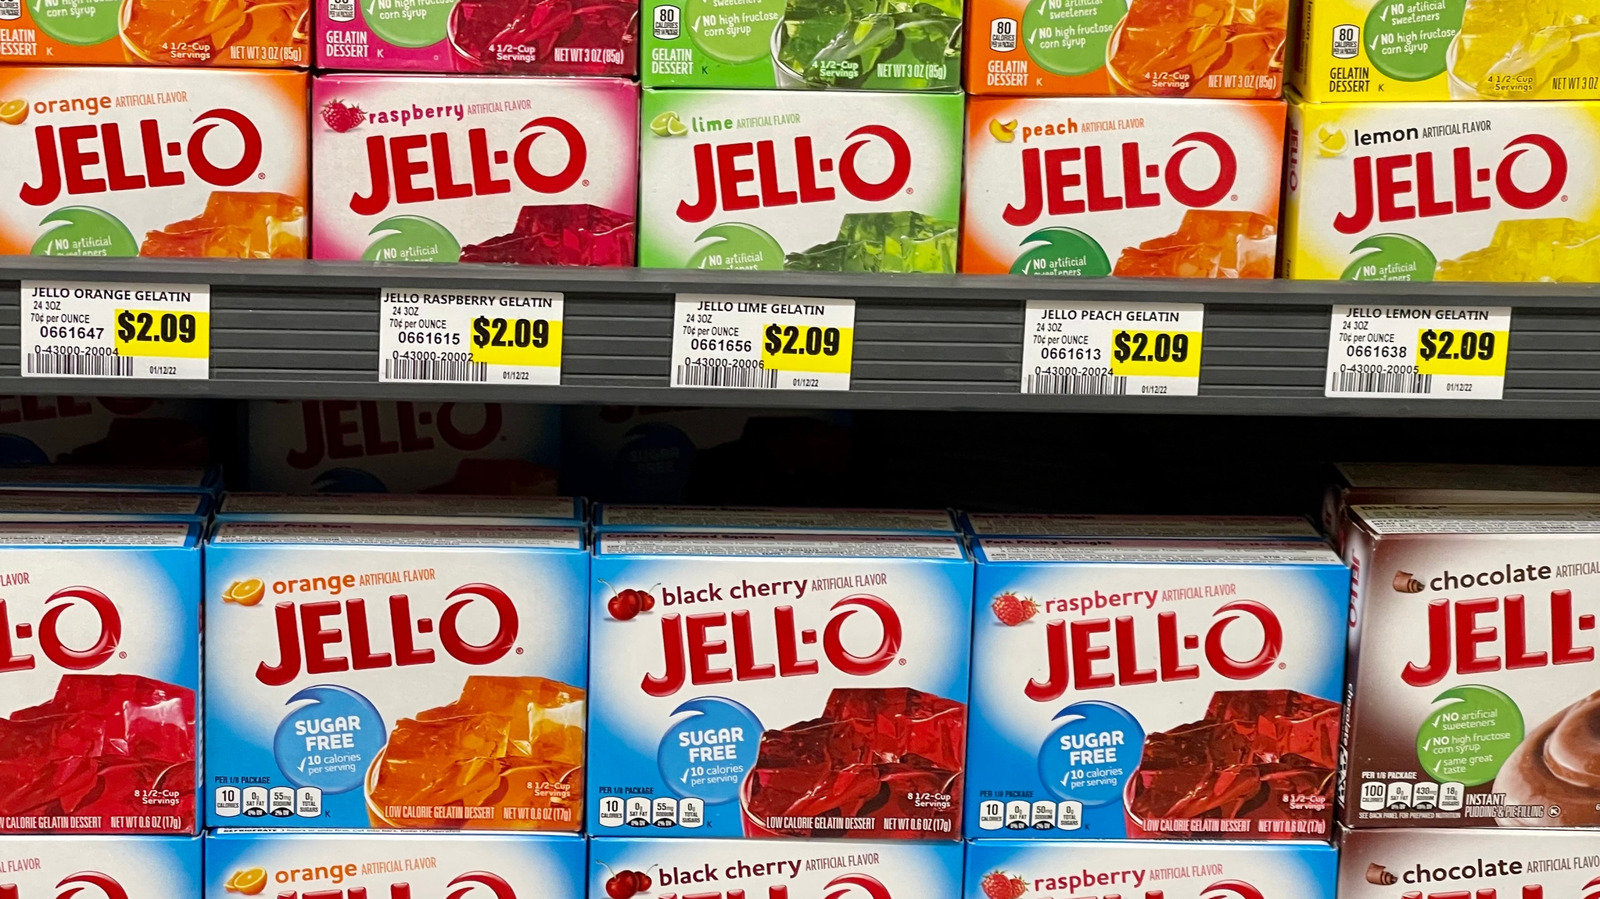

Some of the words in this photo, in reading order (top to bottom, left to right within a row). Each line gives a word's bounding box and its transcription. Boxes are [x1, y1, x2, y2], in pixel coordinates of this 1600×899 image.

[326, 30, 367, 44] GELATIN
[326, 44, 368, 58] DESSERT
[651, 48, 692, 61] GELATIN
[651, 61, 693, 75] DESSERT
[988, 60, 1028, 74] GELATIN
[1330, 67, 1369, 80] GELATIN
[987, 74, 1028, 86] DESSERT
[1329, 80, 1370, 92] DESSERT
[34, 94, 112, 116] orange
[115, 94, 155, 108] ARTIFICIAL
[157, 91, 188, 105] FLAVOR
[369, 103, 464, 126] raspberry
[467, 101, 503, 115] ARTIFICIAL
[505, 99, 532, 112] FLAVOR
[692, 116, 733, 133] lime
[736, 115, 772, 129] ARTIFICIAL
[774, 113, 801, 125] FLAVOR
[1022, 118, 1078, 142] peach
[1081, 120, 1116, 133] ARTIFICIAL
[1118, 118, 1145, 129] FLAVOR
[1355, 125, 1418, 146] lemon
[1422, 125, 1461, 139] ARTIFICIAL
[1462, 120, 1492, 133] FLAVOR
[709, 255, 722, 265] NO
[725, 251, 763, 265] artificial
[1033, 259, 1046, 269] NO
[1049, 255, 1086, 268] artificial
[1363, 265, 1376, 276] NO
[1379, 261, 1416, 275] artificial
[32, 287, 70, 298] JELLO
[74, 288, 131, 300] ORANGE
[135, 290, 191, 302] GELATIN
[384, 293, 419, 304] JELLO
[423, 294, 496, 306] RASPBERRY
[499, 297, 552, 308] GELATIN
[33, 300, 43, 310] 24
[392, 307, 401, 315] 24
[697, 300, 733, 312] JELLO
[738, 302, 768, 313] LIME
[771, 304, 825, 316] GELATIN
[30, 313, 45, 323] 70¢
[46, 314, 59, 324] per
[61, 314, 90, 324] OUNCE
[686, 314, 695, 323] 24
[1041, 309, 1077, 321] JELLO
[1081, 310, 1122, 321] PEACH
[1126, 311, 1179, 322] GELATIN
[1346, 308, 1382, 319] JELLO
[1386, 308, 1432, 320] LEMON
[1435, 309, 1489, 321] GELATIN
[117, 310, 196, 343] $2.09
[389, 318, 403, 329] 70¢
[404, 320, 417, 330] per
[419, 320, 447, 329] OUNCE
[1036, 323, 1045, 332] 24
[1343, 321, 1351, 330] 24
[40, 326, 104, 340] 0661647
[398, 331, 460, 345] 0661615
[473, 316, 549, 348] $2.09
[682, 326, 696, 336] 70¢
[697, 328, 710, 337] per
[711, 327, 739, 337] OUNCE
[1339, 333, 1353, 344] 70¢
[1353, 335, 1366, 344] per
[1367, 333, 1395, 343] OUNCE
[690, 339, 752, 352] 0661656
[764, 323, 840, 357] $2.09
[1033, 335, 1046, 345] 70¢
[1047, 337, 1060, 346] per
[1061, 335, 1089, 345] OUNCE
[1114, 330, 1189, 363] $2.09
[1420, 329, 1495, 361] $2.09
[34, 345, 119, 356] 0-43000-20004
[392, 350, 474, 362] 0-43000-20002
[1041, 347, 1101, 360] 0661613
[1346, 345, 1407, 358] 0661638
[685, 357, 765, 369] 0-43000-20006
[1340, 364, 1419, 374] 0-43000-20005
[149, 366, 177, 375] 01/12/22
[502, 371, 529, 380] 01/12/22
[1035, 366, 1114, 377] 0-43000-20024
[792, 378, 819, 387] 01/12/22
[1141, 385, 1168, 394] 01/12/22
[1446, 383, 1473, 392] 01/12/22
[272, 572, 356, 595] orange
[359, 571, 401, 587] ARTIFICIAL
[403, 568, 436, 583] FLAVOR
[1430, 564, 1552, 592] chocolate
[662, 583, 723, 606] black
[729, 578, 808, 601] cherry
[811, 576, 854, 592] ARTIFICIAL
[855, 573, 887, 587] FLAVOR
[1045, 589, 1159, 616] raspberry
[1161, 587, 1204, 603] ARTIFICIAL
[1205, 583, 1237, 597] FLAVOR
[1442, 712, 1459, 721] NO
[1461, 709, 1498, 720] artificial
[295, 715, 361, 736] SUGAR
[1442, 719, 1495, 731] sweeteners
[306, 733, 354, 752] FREE
[679, 727, 744, 747] SUGAR
[1060, 730, 1124, 750] SUGAR
[1433, 737, 1450, 746] NO
[1451, 735, 1471, 748] high
[1473, 731, 1511, 742] fructose
[689, 745, 736, 763] FREE
[1070, 748, 1117, 766] FREE
[1433, 746, 1453, 754] corn
[1455, 744, 1480, 757] syrup
[308, 755, 321, 766] 10
[323, 752, 361, 765] calories
[1443, 757, 1467, 766] same
[1469, 754, 1493, 766] great
[308, 766, 323, 777] per
[324, 762, 356, 775] serving
[691, 766, 704, 776] 10
[706, 763, 744, 775] calories
[1070, 769, 1084, 780] 10
[1086, 767, 1123, 778] calories
[1443, 765, 1466, 774] taste
[691, 777, 706, 787] per
[707, 774, 738, 786] serving
[1071, 779, 1085, 791] per
[1087, 777, 1118, 788] serving
[275, 861, 357, 884] orange
[361, 860, 403, 876] ARTIFICIAL
[405, 857, 437, 870] FLAVOR
[659, 865, 718, 887] black
[725, 860, 802, 882] cherry
[805, 857, 846, 872] ARTIFICIAL
[848, 853, 879, 867] FLAVOR
[1402, 858, 1522, 884] chocolate
[1526, 856, 1571, 873] ARTIFICIAL
[1034, 869, 1145, 895] raspberry
[1149, 866, 1190, 881] ARTIFICIAL
[1192, 863, 1223, 877] FLAVOR
